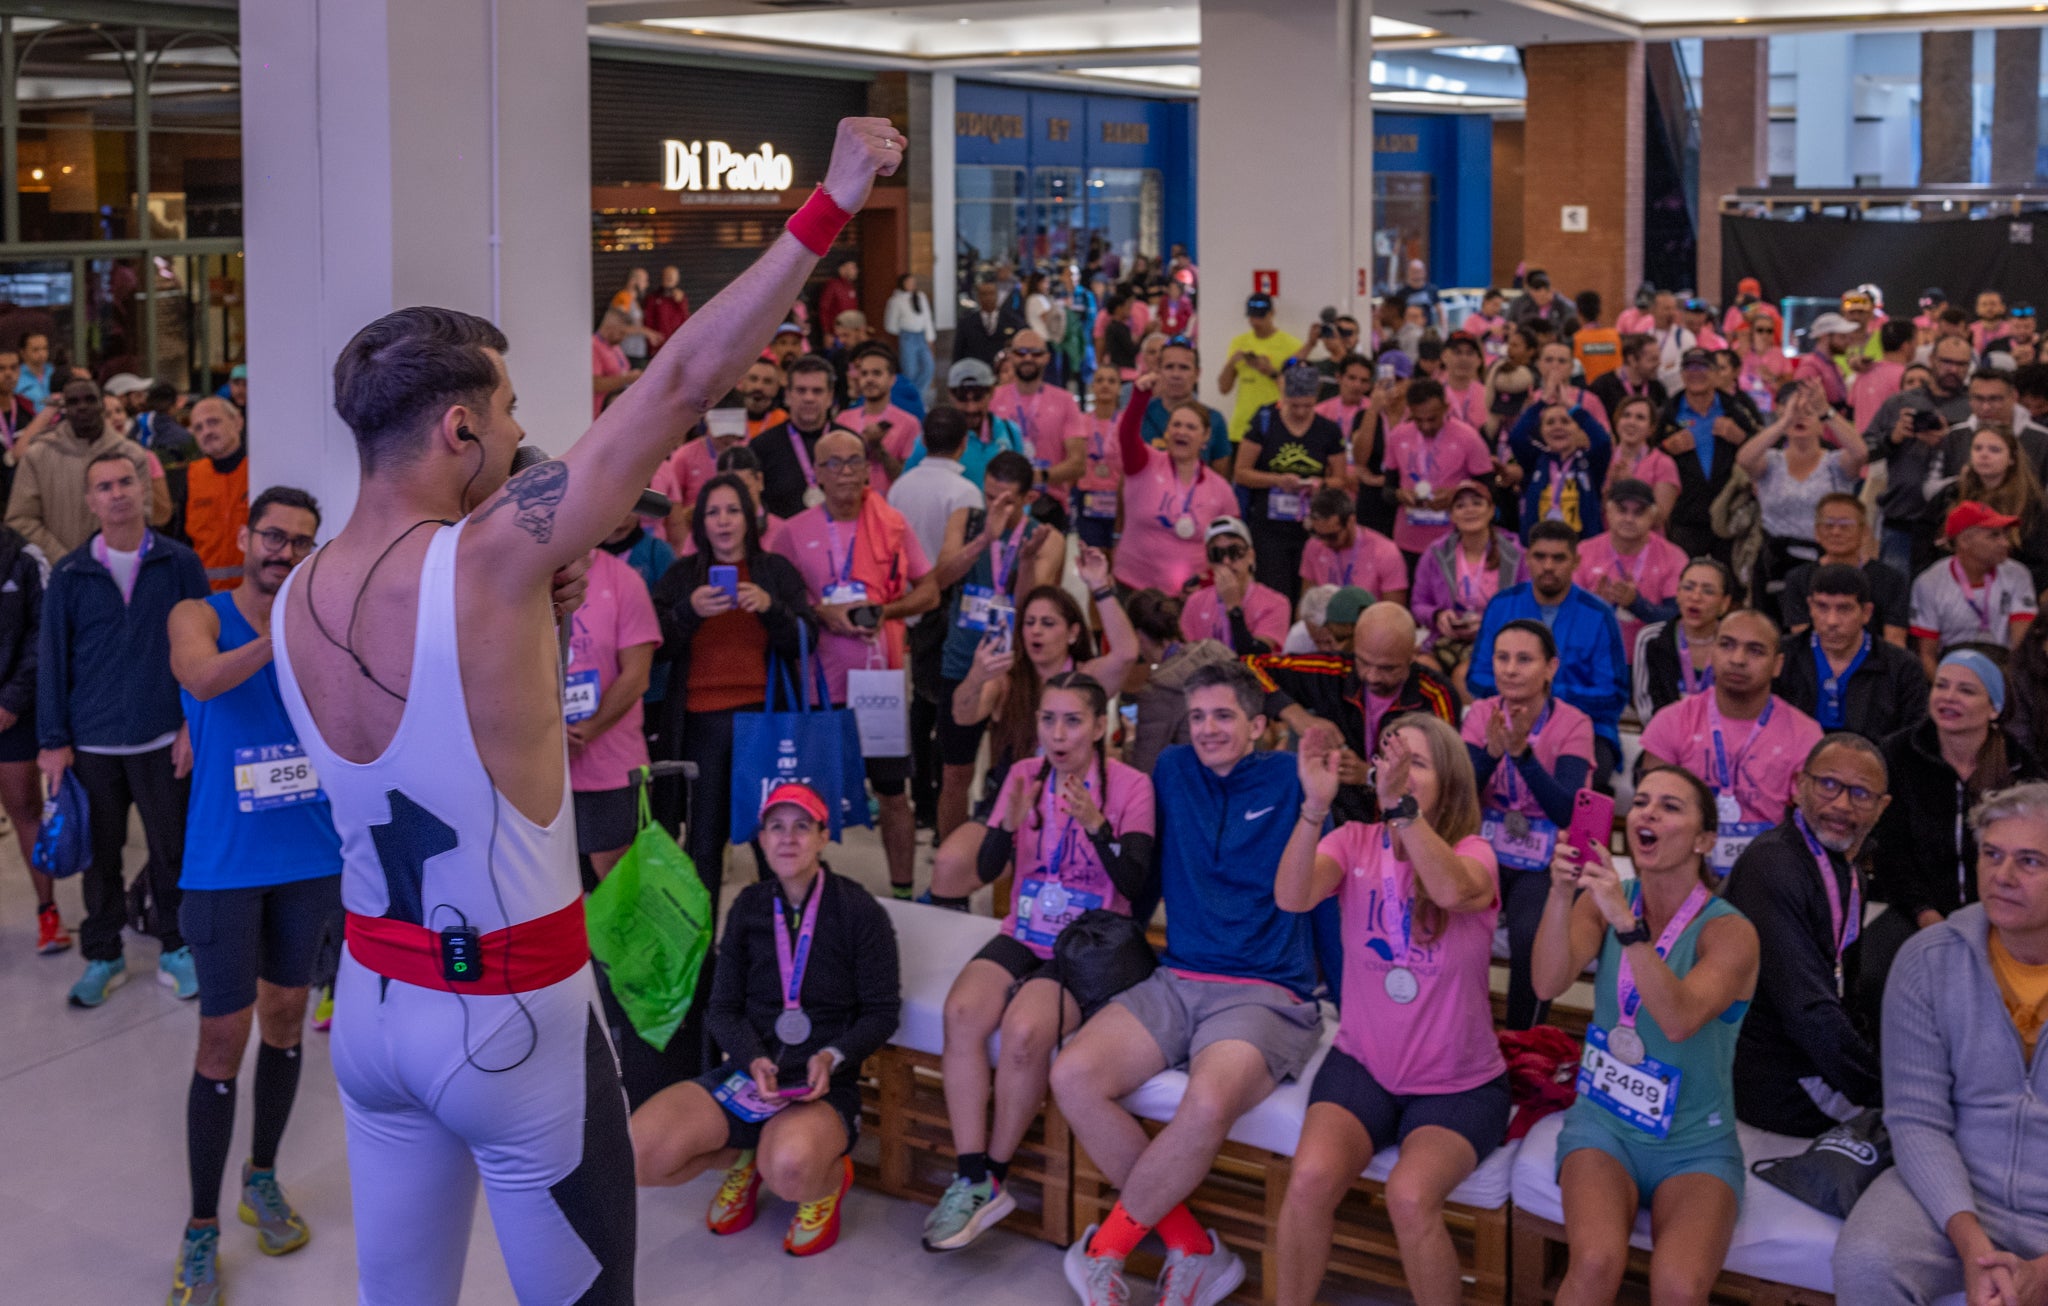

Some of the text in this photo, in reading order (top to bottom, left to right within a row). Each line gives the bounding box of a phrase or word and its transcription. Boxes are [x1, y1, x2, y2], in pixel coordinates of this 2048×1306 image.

[664, 139, 793, 191] Di Paolo
[270, 764, 312, 783] 256
[1604, 1065, 1661, 1103] 2489
